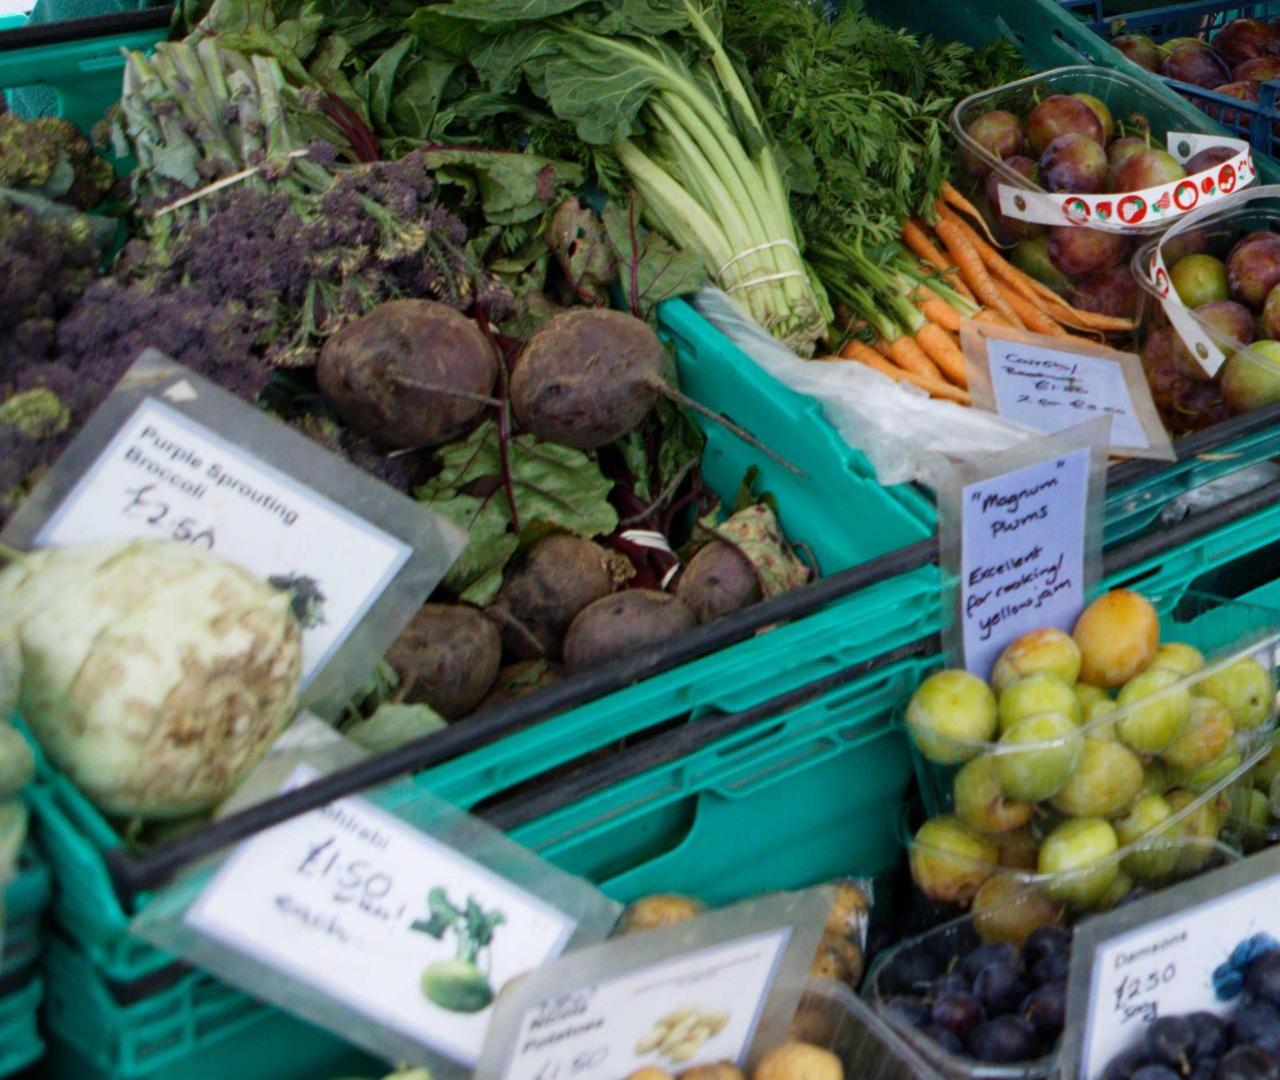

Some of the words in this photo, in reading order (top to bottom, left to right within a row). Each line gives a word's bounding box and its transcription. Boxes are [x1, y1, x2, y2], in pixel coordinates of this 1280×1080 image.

[125, 445, 208, 500] Broccoli
[140, 425, 204, 469] Purple
[206, 462, 299, 527] Sprouting
[968, 546, 1043, 587] Excellent
[966, 591, 992, 619] for
[979, 600, 1033, 640] yellow
